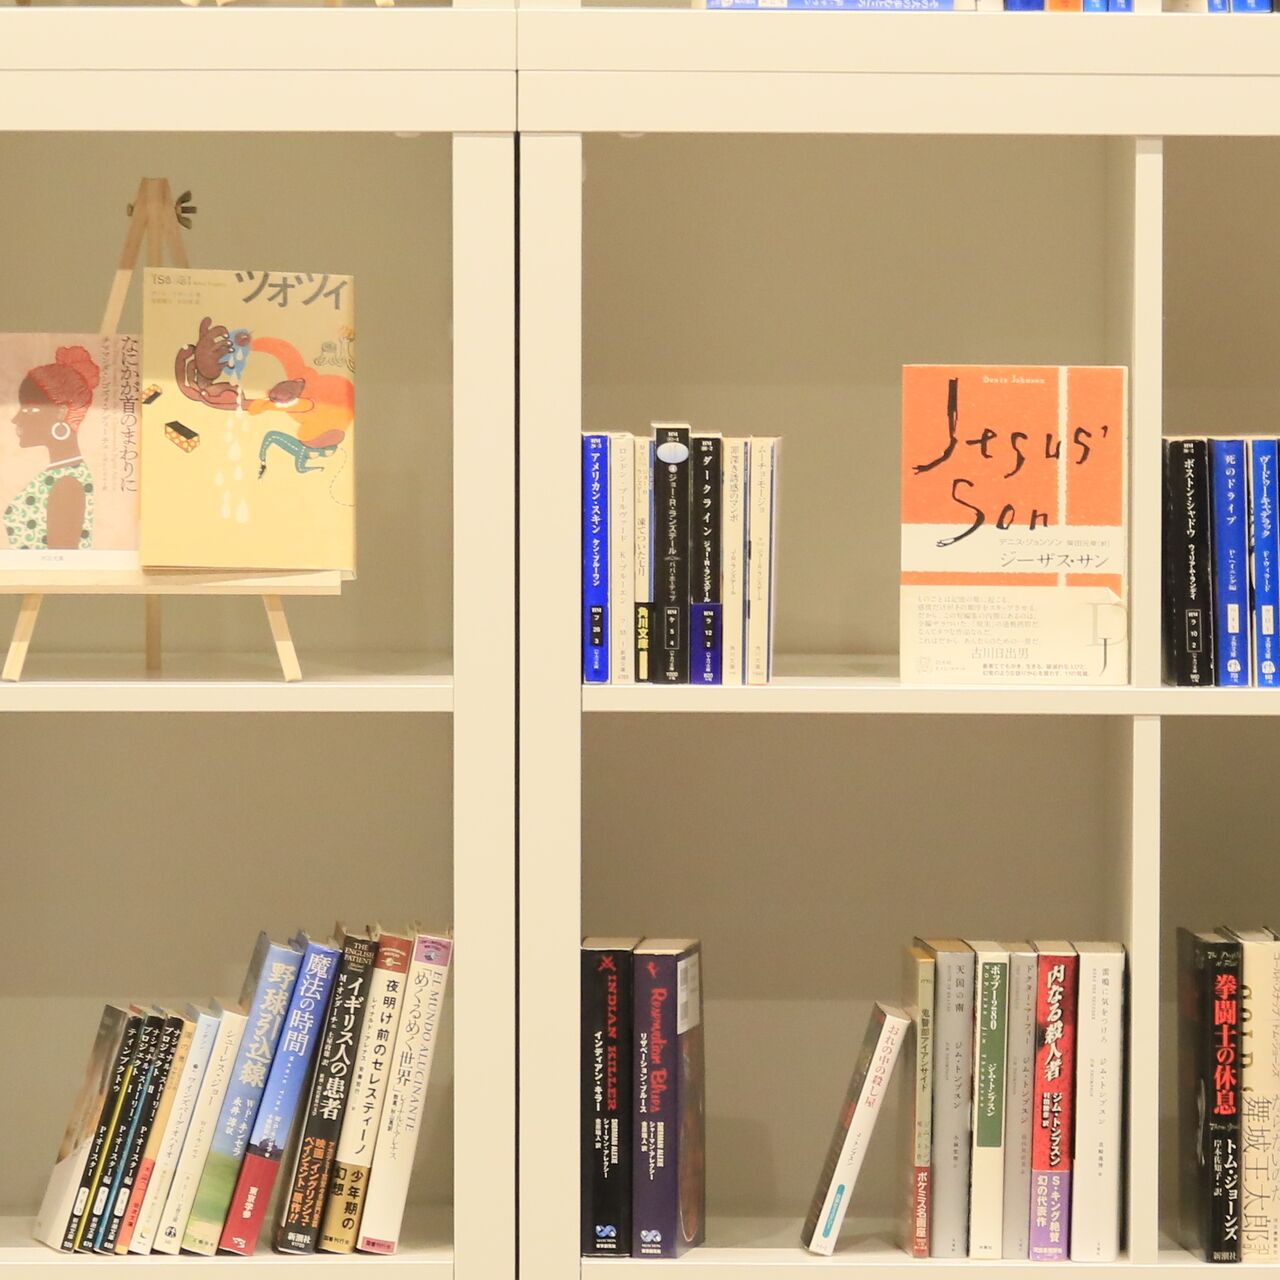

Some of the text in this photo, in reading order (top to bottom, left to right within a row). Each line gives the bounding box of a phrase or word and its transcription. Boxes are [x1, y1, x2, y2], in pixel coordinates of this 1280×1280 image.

[235, 271, 347, 309] ツォツィ
[121, 336, 140, 492] なにかが首のまわりに
[913, 377, 1108, 478] Jesus'
[591, 453, 600, 534] アメリカン・スキン
[703, 455, 713, 536] ダークライン
[936, 479, 1049, 547] Son
[1001, 552, 1109, 568] ジーザス・サン
[638, 607, 648, 649] 角川文庫
[344, 948, 374, 957] ENGLISH
[344, 954, 373, 964] PATIENT
[435, 971, 443, 985] EL
[239, 961, 294, 1089] 野球引込線
[284, 953, 333, 1057] 魔法の時間
[953, 964, 966, 1111] 天国の南 ジム・トンプスン
[1044, 964, 1066, 1081] 内なる殺人者
[320, 977, 365, 1121] イギリス人の患者
[354, 979, 400, 1155] 夜明け前のセレスティーノ
[594, 1030, 603, 1112] インディアン・キラー
[607, 975, 617, 1111] INDIAN KILLER
[640, 1033, 648, 1113] リザベーション・ブルース
[865, 1025, 899, 1108] おれの中の殺し屋
[1215, 974, 1237, 1115] 拳闘士の休息
[650, 1068, 667, 1113] Blues
[986, 1064, 996, 1117] ジム・トンプスン
[1050, 1092, 1062, 1166] ジム・トンプスン
[342, 1169, 364, 1231] 少年期の
[916, 1172, 928, 1238] ポケミス名画座
[1036, 1175, 1048, 1227] 幻の代表作
[1213, 1139, 1222, 1197] 岸本佐知子・訳
[1223, 1138, 1238, 1241] トム・ジョーンズ
[287, 1233, 311, 1244] 新潮社
[1049, 1176, 1061, 1243] S・キング絶賛
[1213, 1251, 1238, 1260] 新潮社
